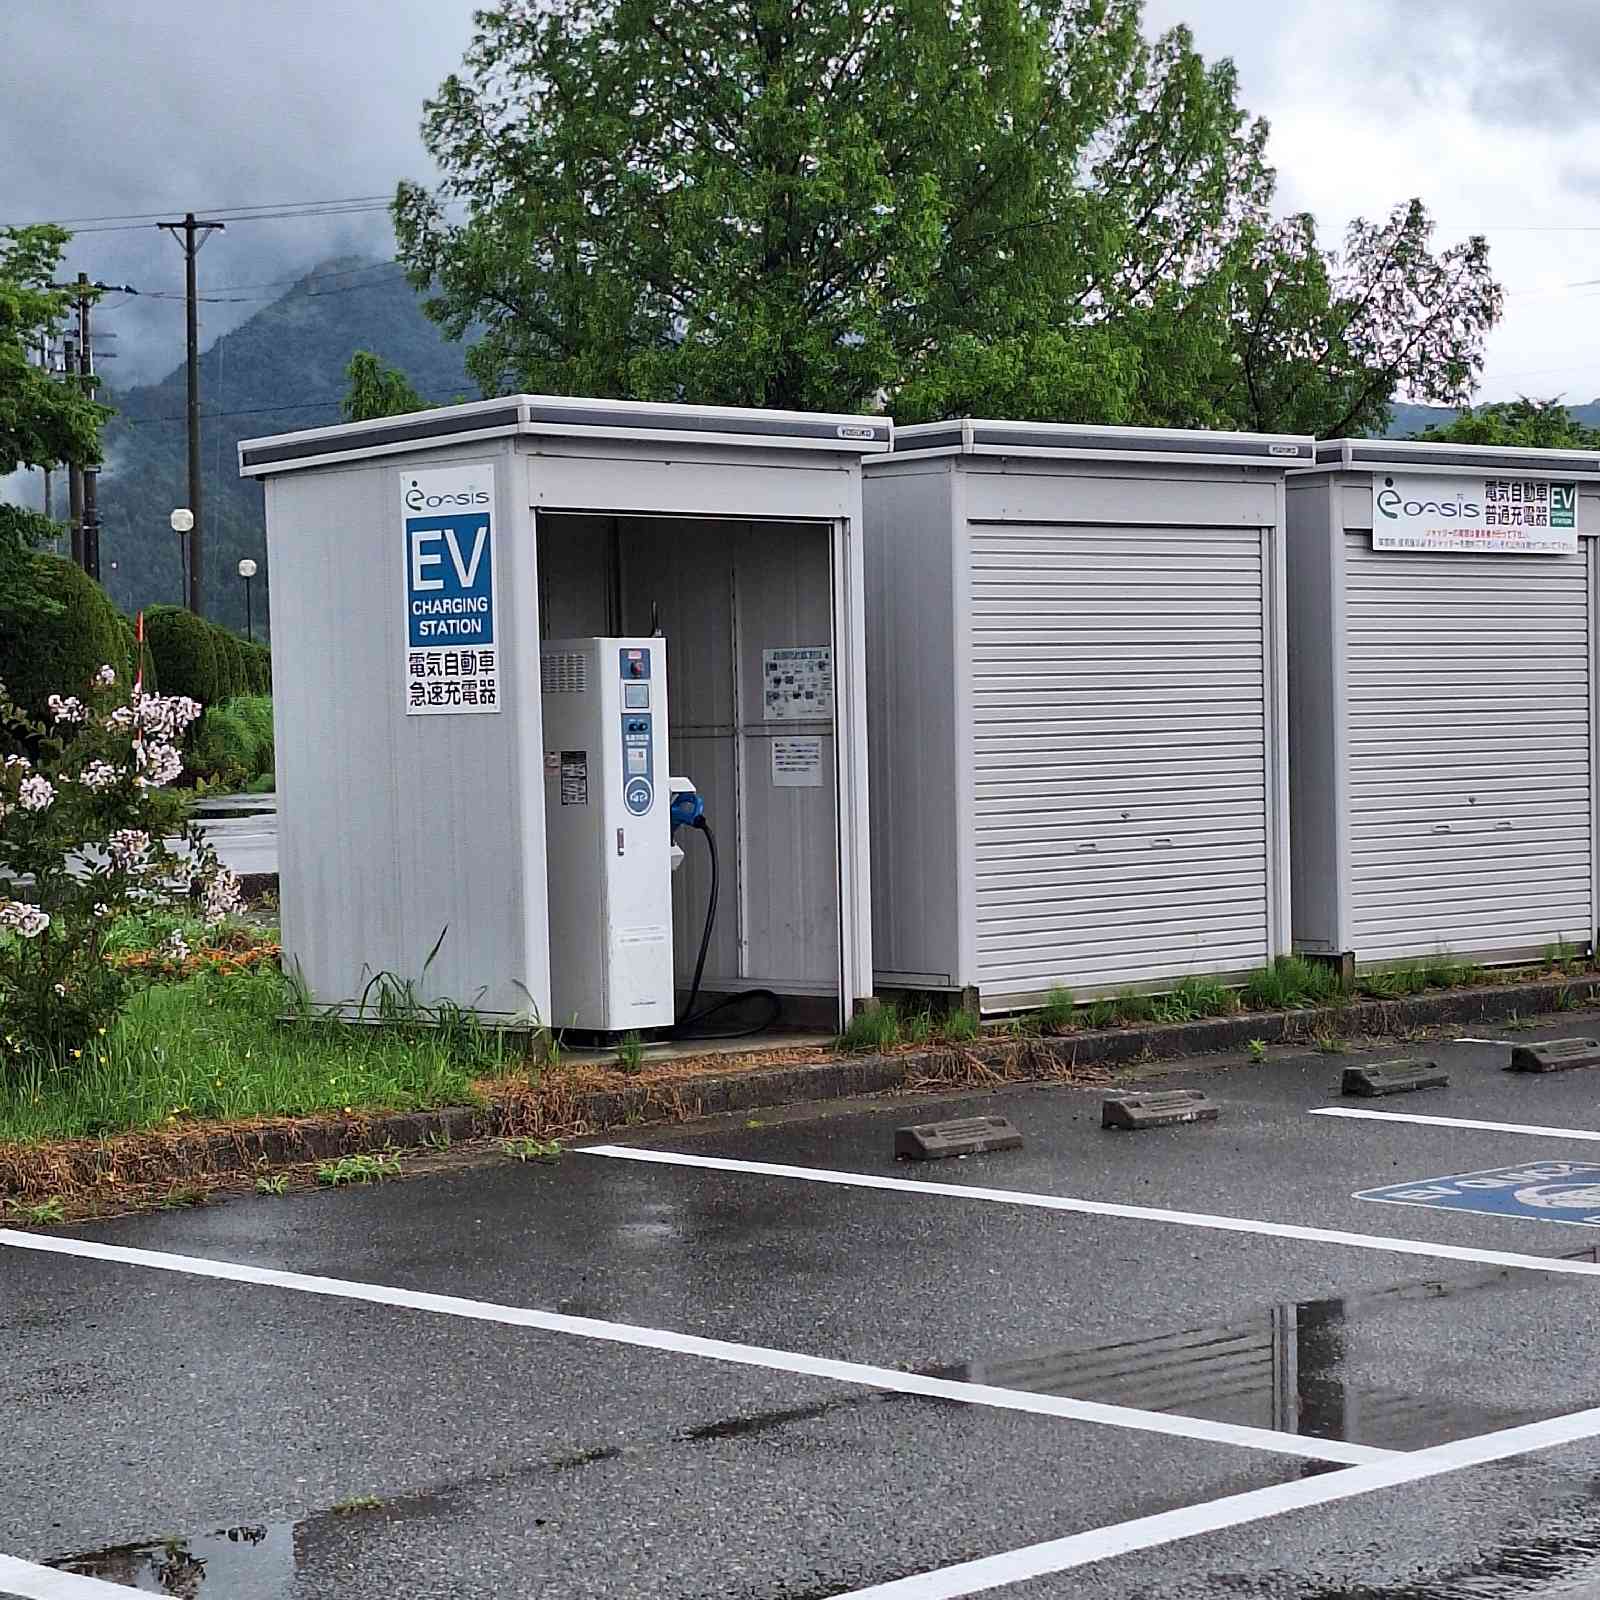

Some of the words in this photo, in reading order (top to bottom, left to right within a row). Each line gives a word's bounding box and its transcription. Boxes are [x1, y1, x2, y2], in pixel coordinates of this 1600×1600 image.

[1485, 480, 1548, 503] 電気自動車
[1551, 487, 1575, 509] EV
[1485, 504, 1548, 527] 普通充電器
[411, 526, 488, 591] EV
[412, 596, 489, 616] CHARGING
[418, 618, 482, 636] STATION
[408, 650, 496, 678] 電気自動車
[409, 678, 497, 707] 急速充電器
[1384, 1185, 1463, 1200] EV
